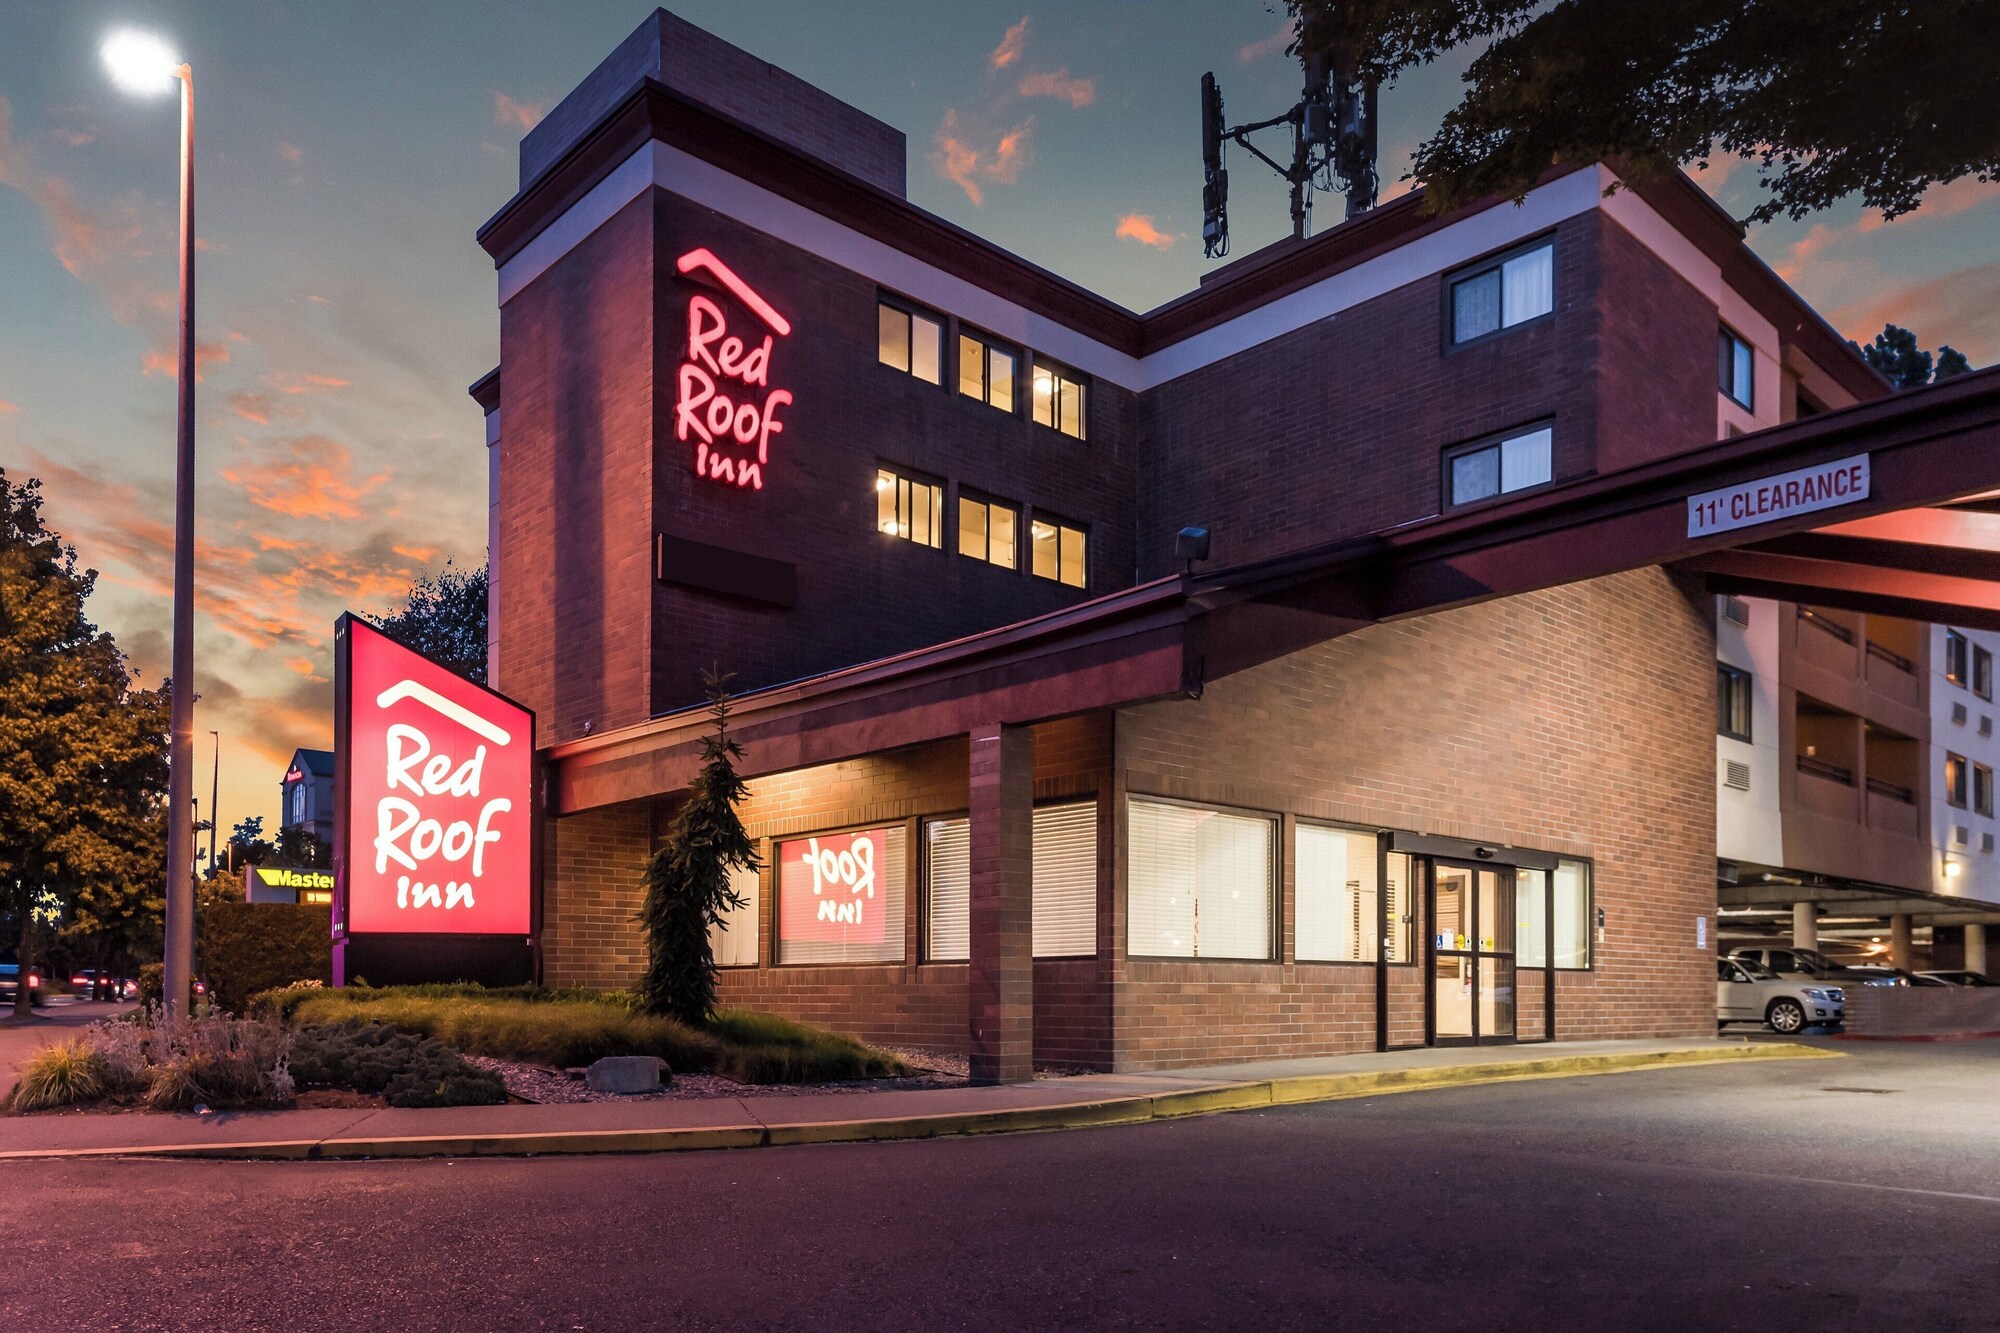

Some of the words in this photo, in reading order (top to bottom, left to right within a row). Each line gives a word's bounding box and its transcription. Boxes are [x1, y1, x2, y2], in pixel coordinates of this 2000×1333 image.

[689, 295, 773, 387] Red
[677, 364, 793, 464] Roof
[1730, 464, 1863, 521] CLEARANCE
[386, 723, 486, 797] Red
[373, 796, 512, 878] Roof
